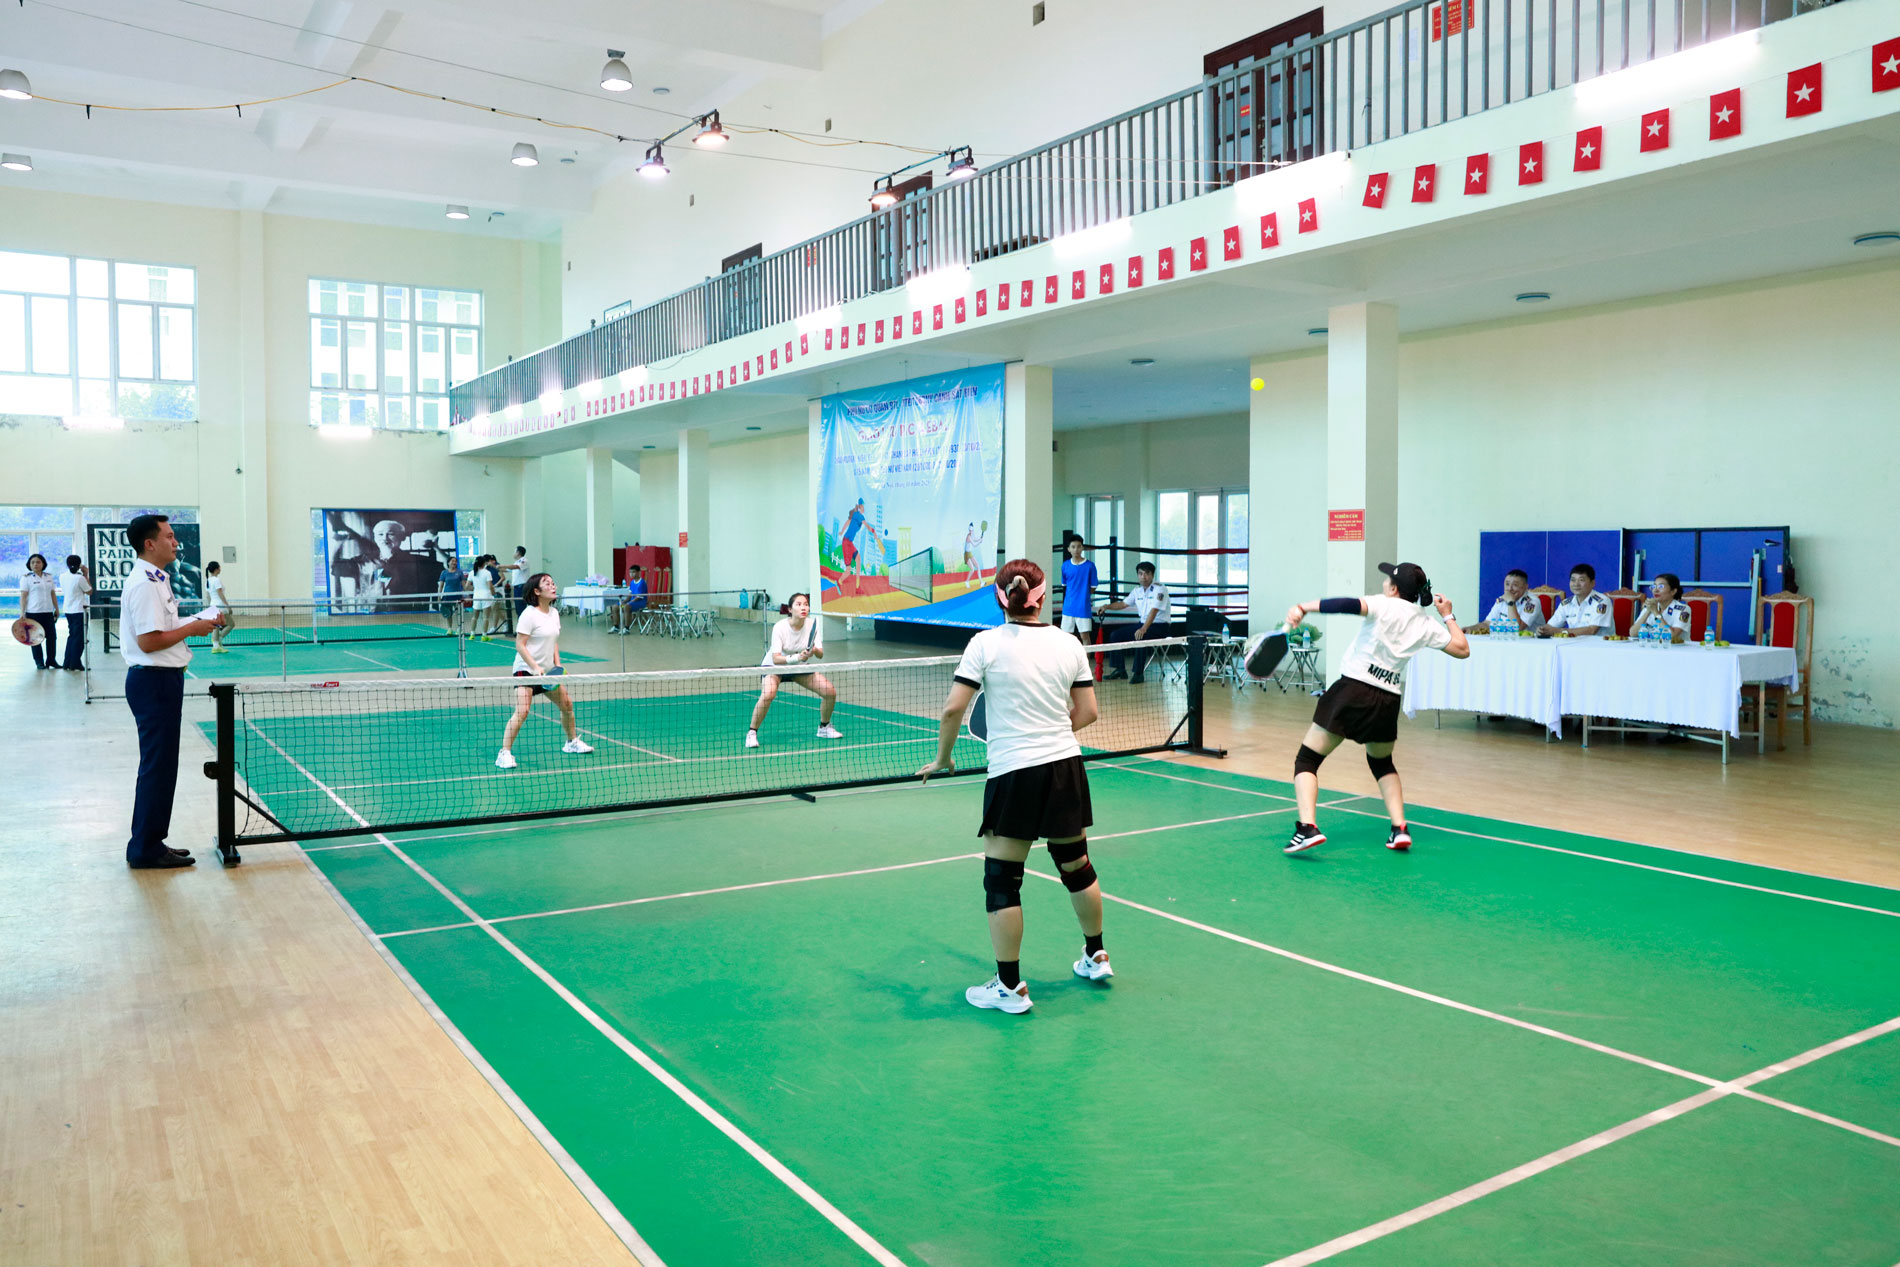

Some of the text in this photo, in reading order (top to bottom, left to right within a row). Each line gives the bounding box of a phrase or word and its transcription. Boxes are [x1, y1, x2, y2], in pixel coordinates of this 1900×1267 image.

[98, 530, 132, 547] NO
[98, 549, 133, 559] PAIN
[98, 561, 134, 577] NO
[99, 580, 124, 590] GAI
[1368, 663, 1394, 685] MIPA
